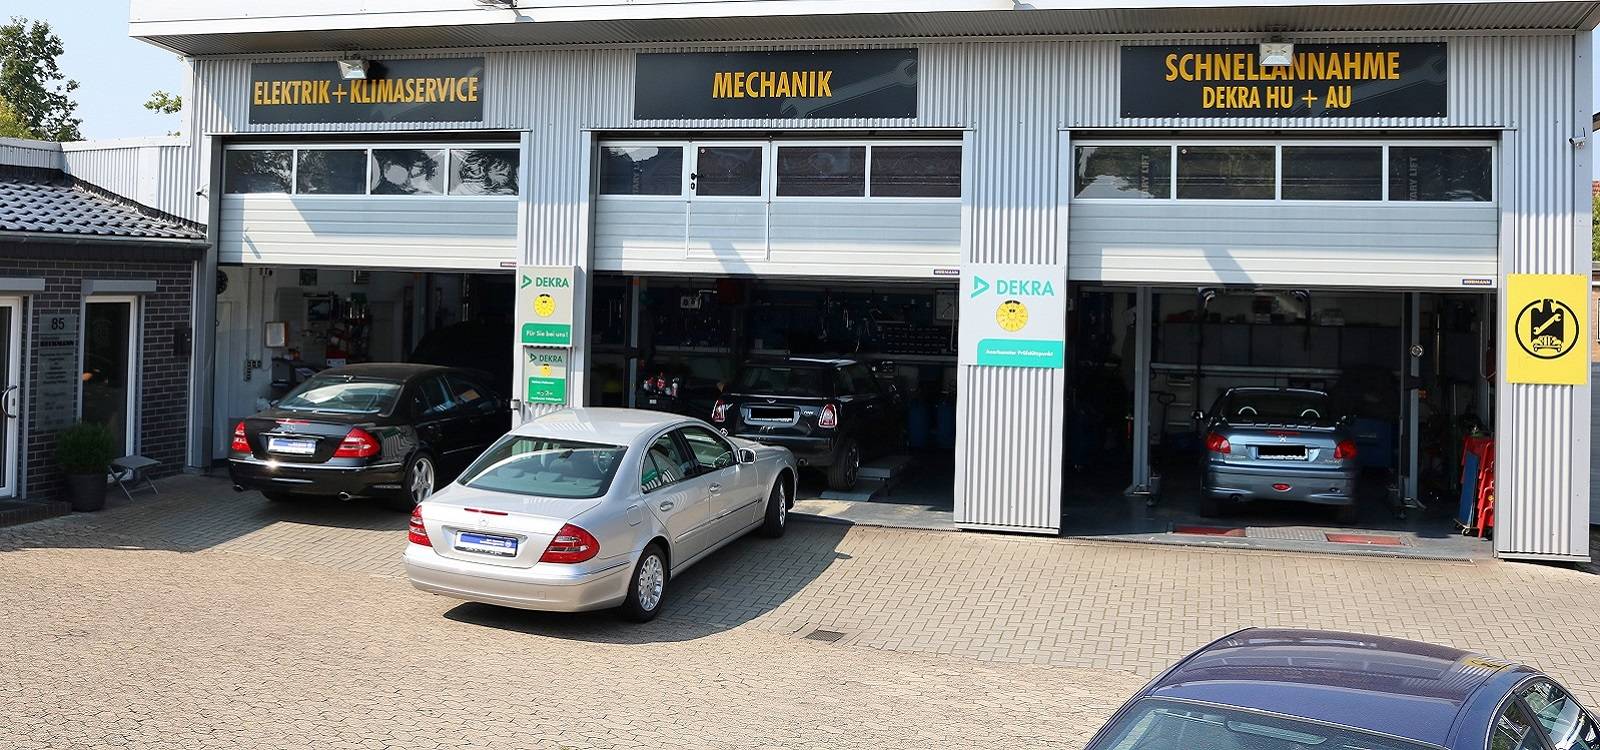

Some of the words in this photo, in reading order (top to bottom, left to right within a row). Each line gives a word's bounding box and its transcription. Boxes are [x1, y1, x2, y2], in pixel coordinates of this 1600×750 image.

[1165, 52, 1400, 82] SCHNELLANNAHME
[253, 80, 331, 106] ELEKTRIK
[349, 77, 479, 104] KLIMASERVICE
[712, 70, 833, 98] MECHANIK
[1202, 86, 1262, 109] DEKRA
[1266, 85, 1294, 109] HU
[1301, 89, 1318, 108] +
[1325, 85, 1352, 109] AU
[1409, 156, 1418, 177] LIFT
[535, 277, 570, 288] DEKRA
[996, 279, 1055, 297] DEKRA
[51, 317, 65, 330] 85
[539, 354, 563, 363] DEKRA
